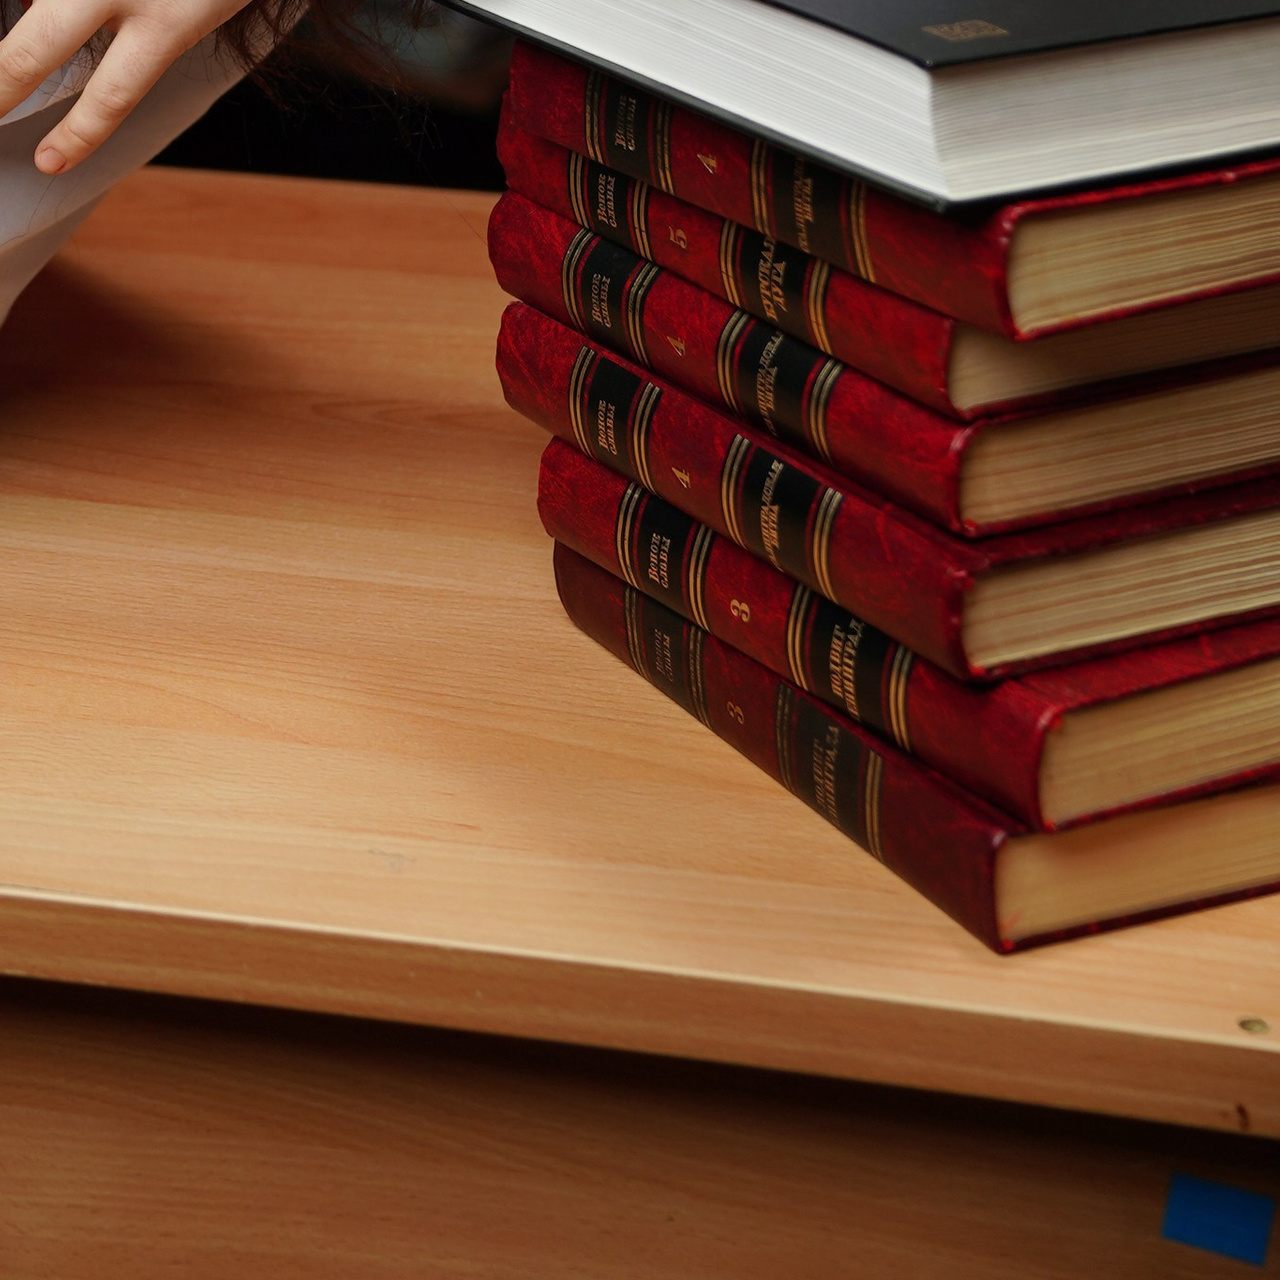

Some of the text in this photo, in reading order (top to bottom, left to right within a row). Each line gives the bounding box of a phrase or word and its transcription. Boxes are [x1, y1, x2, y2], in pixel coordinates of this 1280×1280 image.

[696, 152, 718, 175] 4
[668, 224, 688, 250] 5
[770, 260, 787, 313] ДУГА
[666, 335, 686, 357] 4
[670, 465, 692, 489] 4
[729, 597, 751, 624] 3
[828, 623, 847, 699] ПОДВИГ
[726, 700, 745, 725] 3
